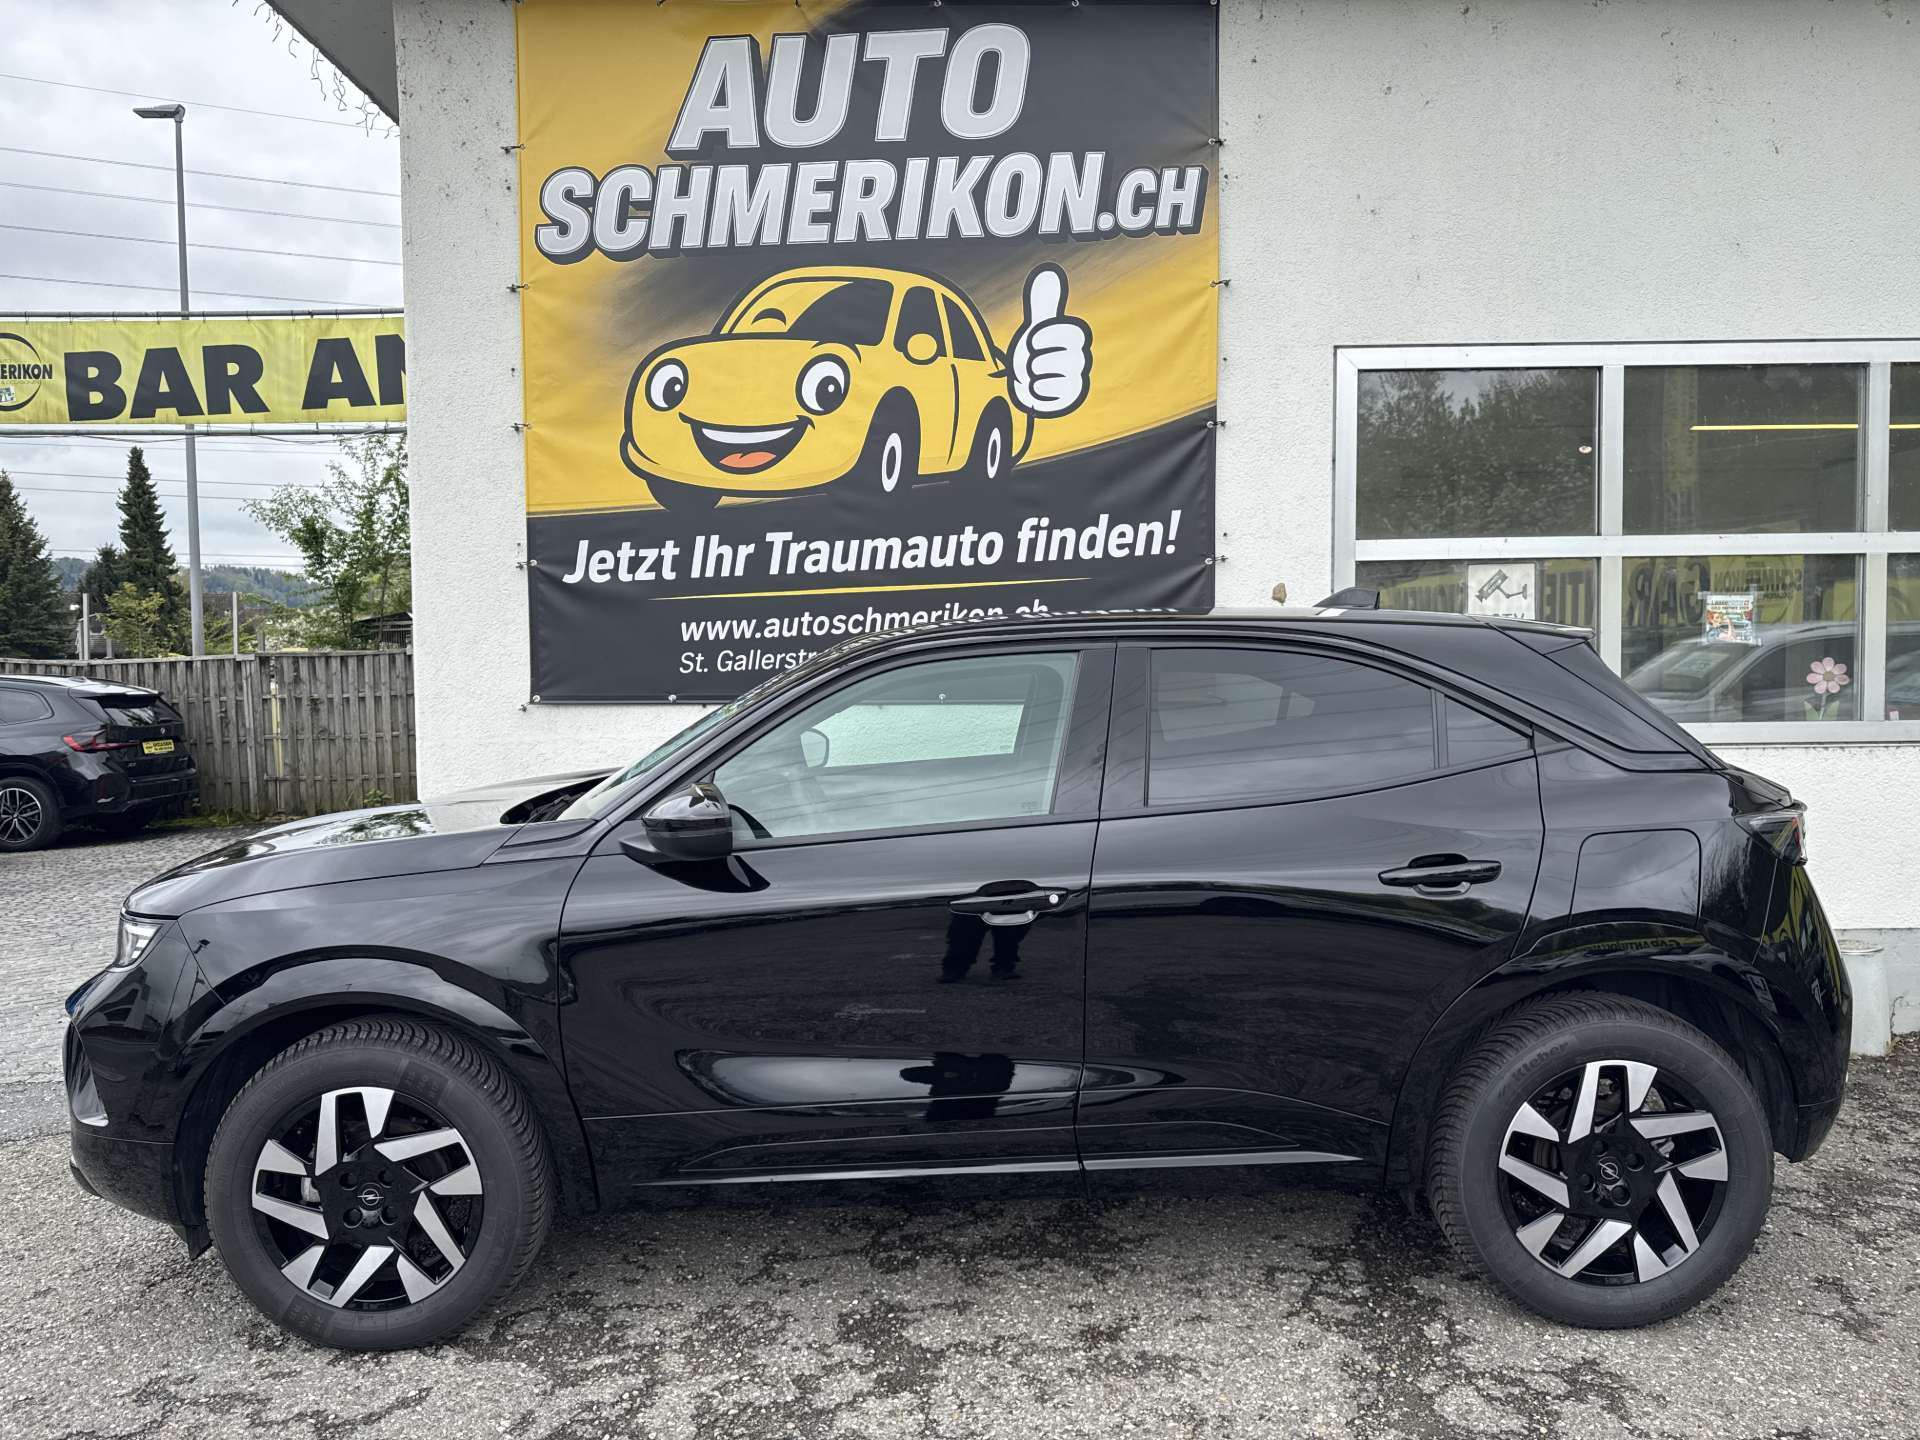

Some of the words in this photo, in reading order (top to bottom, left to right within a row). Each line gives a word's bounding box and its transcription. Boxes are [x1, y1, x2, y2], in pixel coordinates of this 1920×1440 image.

[669, 24, 1031, 153] AUTO
[537, 151, 1203, 257] SCHMERIKON.CH
[64, 344, 271, 422] BAR
[562, 539, 680, 584] Jetzt
[690, 534, 755, 580] Ihr
[764, 524, 1004, 576] Traumauto
[1015, 509, 1183, 565] finden!
[681, 599, 1049, 642] www.autoschmerik
[679, 652, 709, 674] St.
